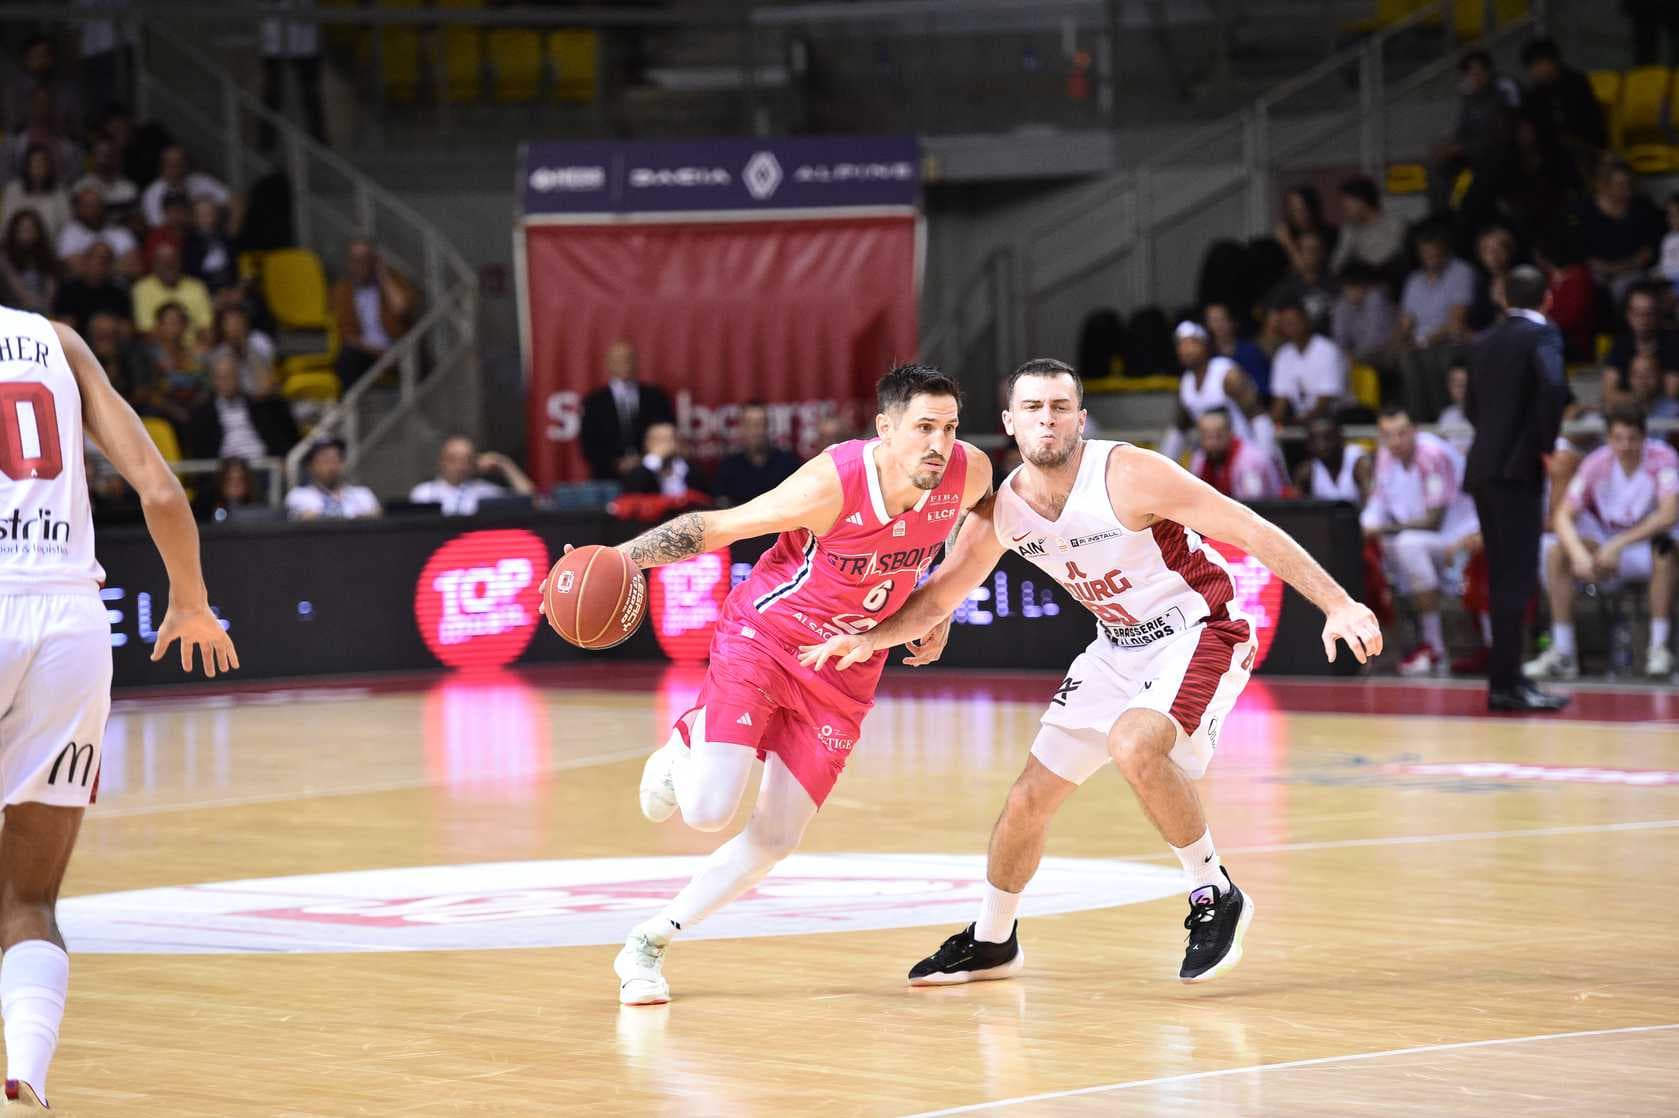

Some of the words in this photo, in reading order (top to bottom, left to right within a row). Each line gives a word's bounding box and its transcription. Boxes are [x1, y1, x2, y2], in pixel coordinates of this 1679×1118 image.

[1018, 542, 1046, 556] AIN
[862, 579, 894, 612] 6
[1113, 616, 1166, 638] BRASSERIE
